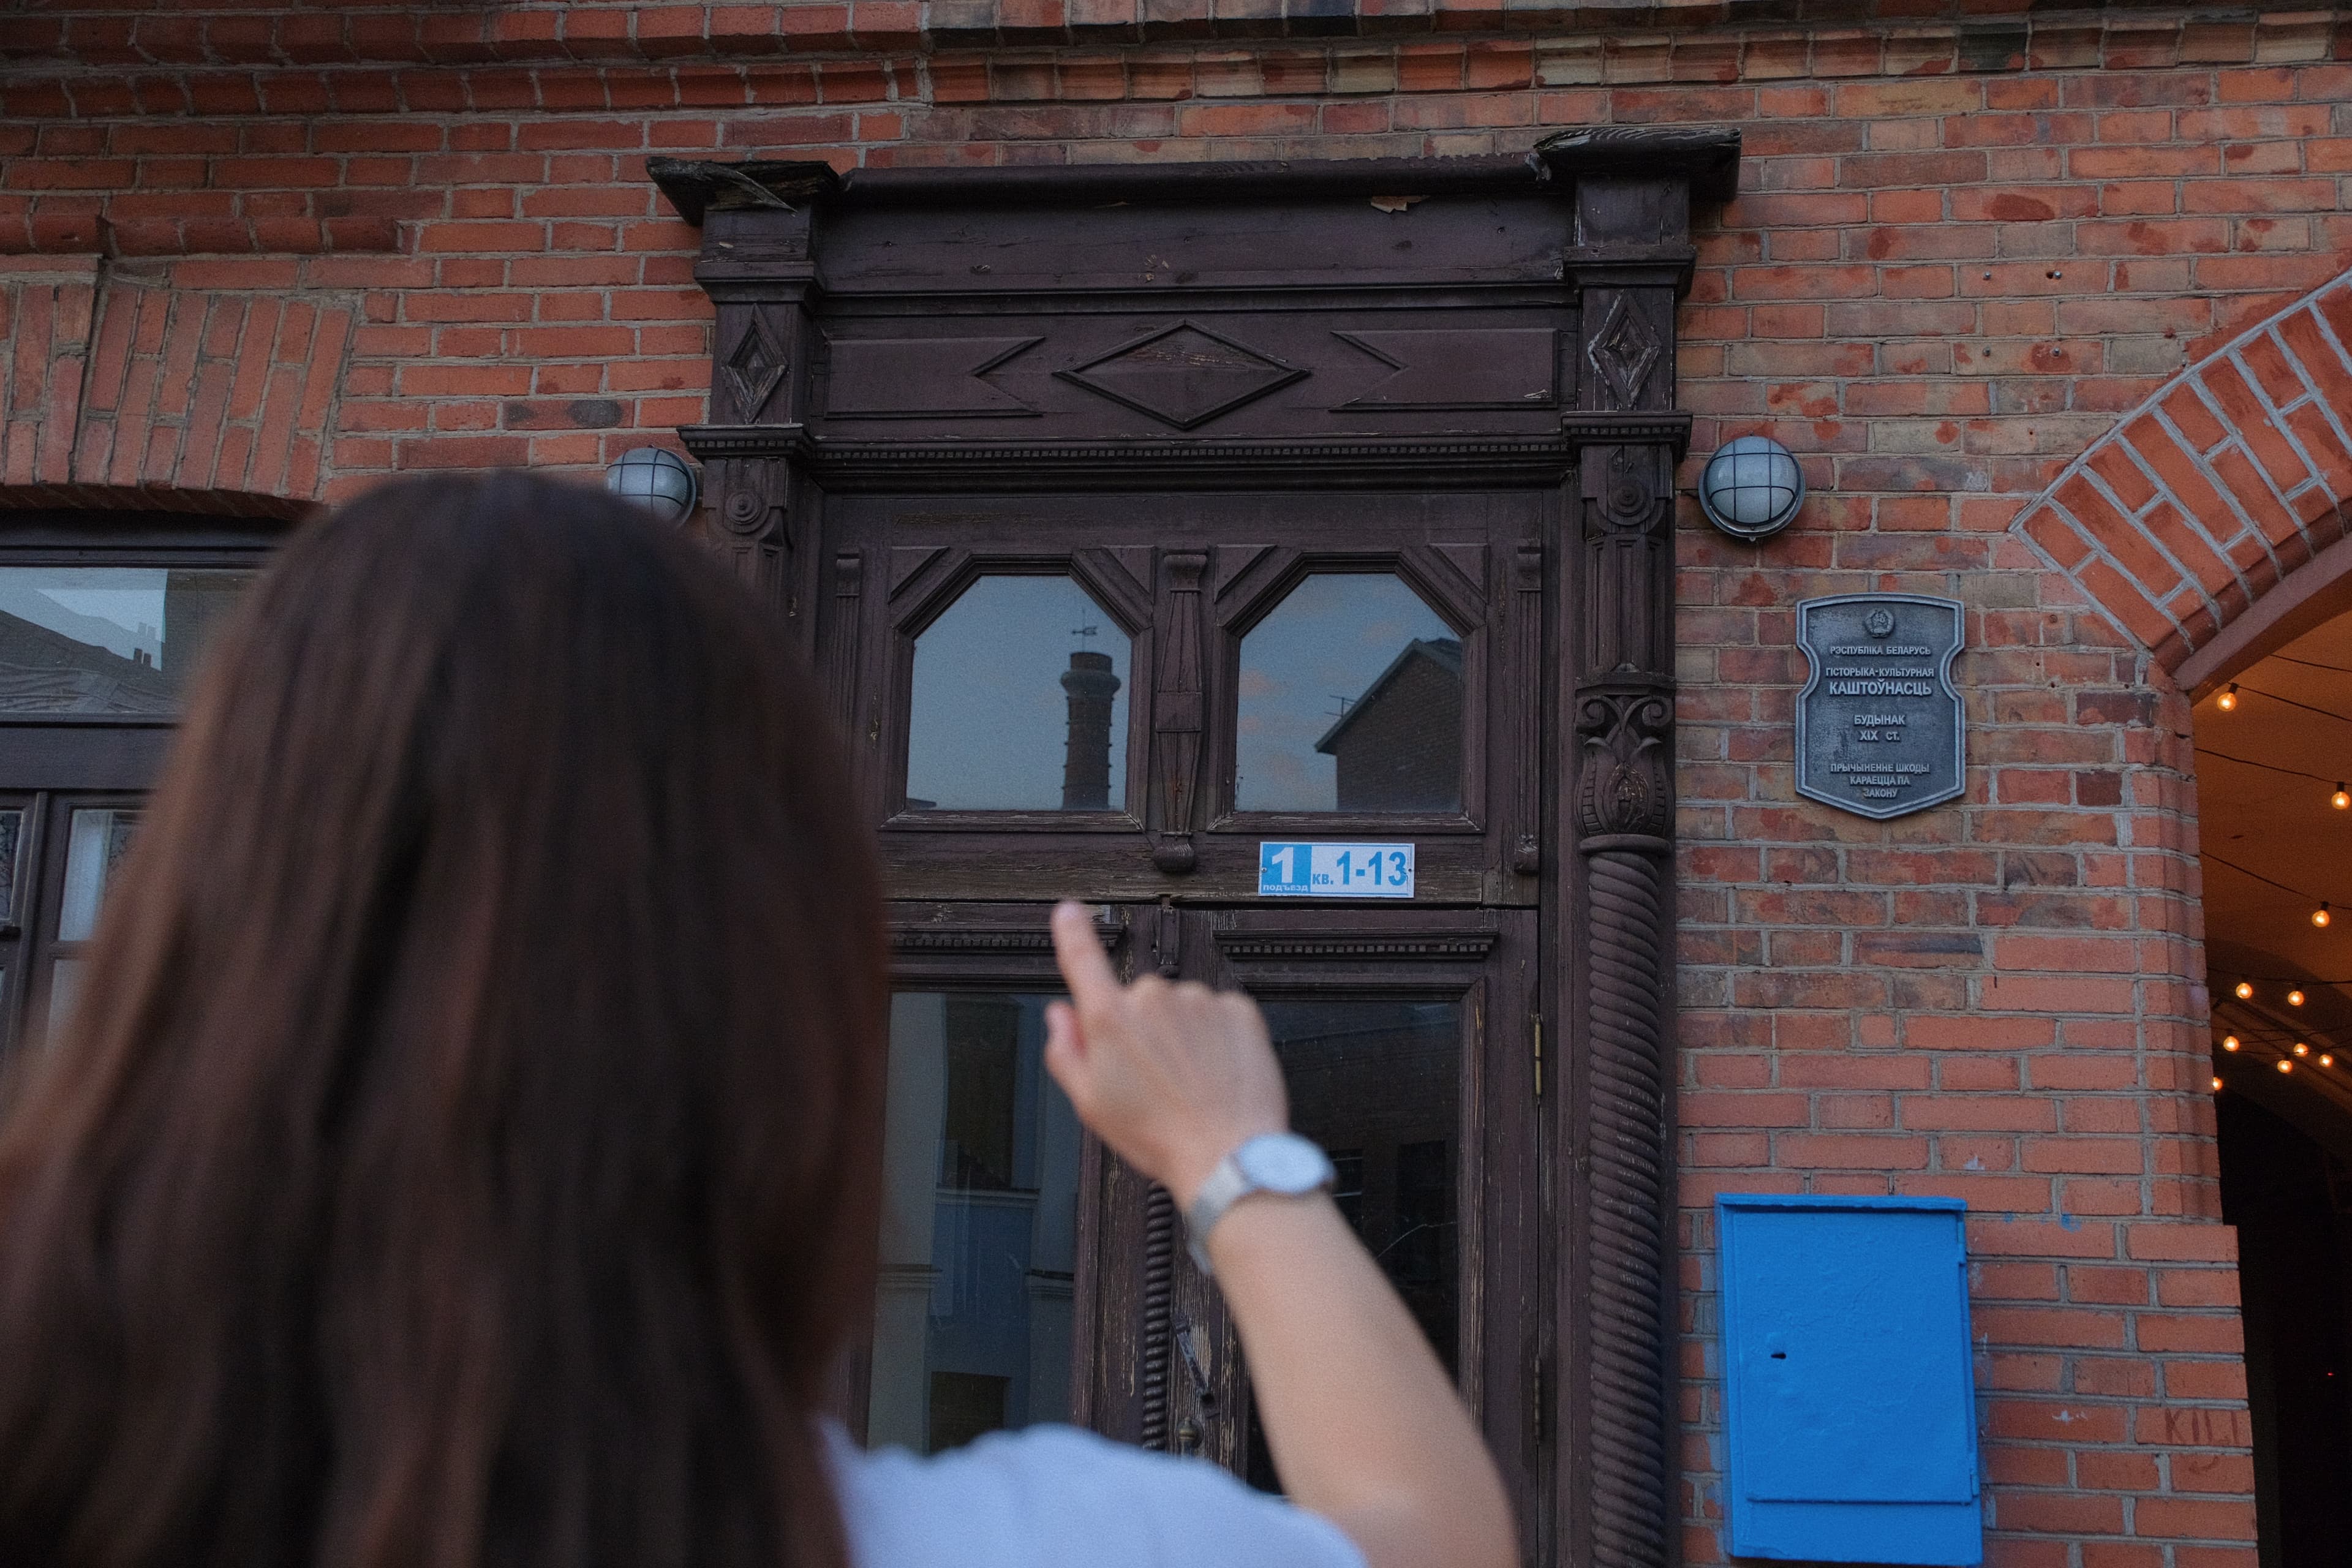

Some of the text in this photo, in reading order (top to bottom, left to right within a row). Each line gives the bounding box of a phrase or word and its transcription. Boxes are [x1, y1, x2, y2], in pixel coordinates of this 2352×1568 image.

[1830, 646, 1931, 655] РЭСПУБЛІКА БЕЛАРУСЬ
[1826, 668, 1934, 677] ГІСТОРЫКА-КУЛЬТУРНАЯ
[1830, 679, 1932, 696] КАШТОЎНАСЦЬ
[1854, 715, 1905, 727] БУДЫНАК
[1830, 763, 1930, 774] ПРЫЧЫНЕННЕ ШКОДЫ
[1850, 776, 1910, 786] КАРАЕЦЦА ПА
[1863, 788, 1898, 798] ЗАКОНУ
[1272, 846, 1294, 883] 1
[1336, 851, 1407, 886] 1-13
